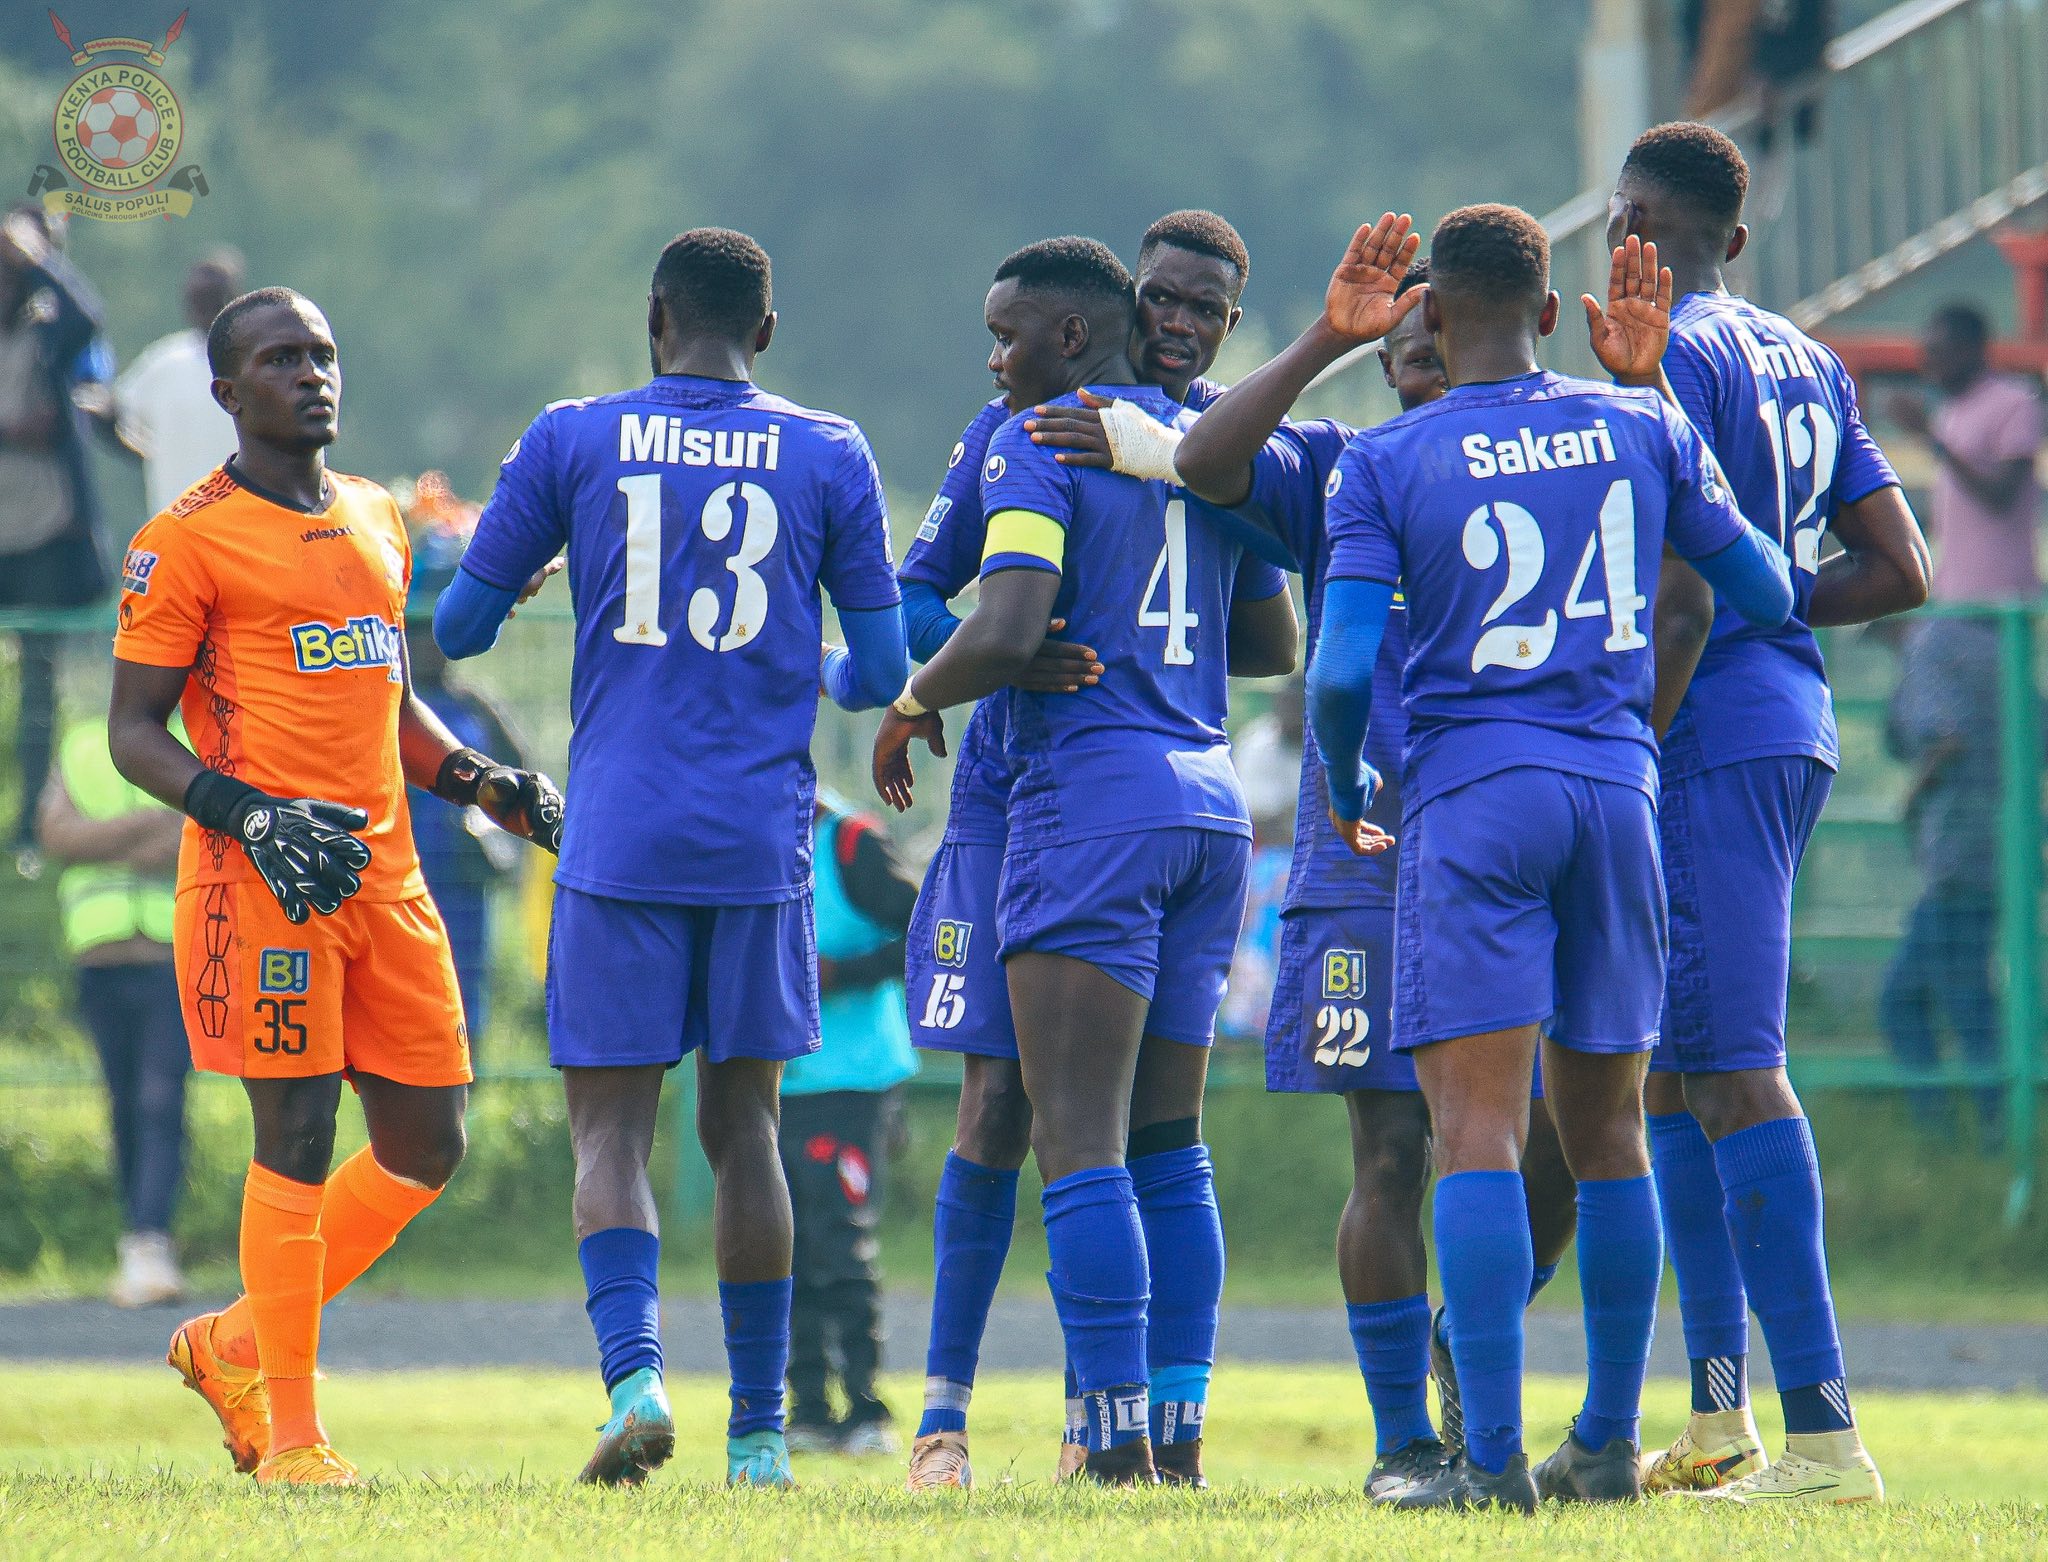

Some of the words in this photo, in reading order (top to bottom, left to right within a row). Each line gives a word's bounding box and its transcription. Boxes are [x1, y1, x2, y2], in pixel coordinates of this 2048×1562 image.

[619, 413, 781, 471] Misuri
[1460, 419, 1617, 480] Sakari
[1759, 398, 1838, 576] 12
[612, 473, 779, 652] 13
[1137, 499, 1199, 666] 4
[1461, 479, 1648, 674] 24
[265, 955, 304, 988] B!
[938, 925, 966, 961] B!
[919, 973, 966, 1029] 15
[1328, 955, 1360, 993] B!
[254, 999, 307, 1055] 35
[1314, 1005, 1371, 1067] 22
[1096, 1390, 1112, 1451] TAPEDESIG
